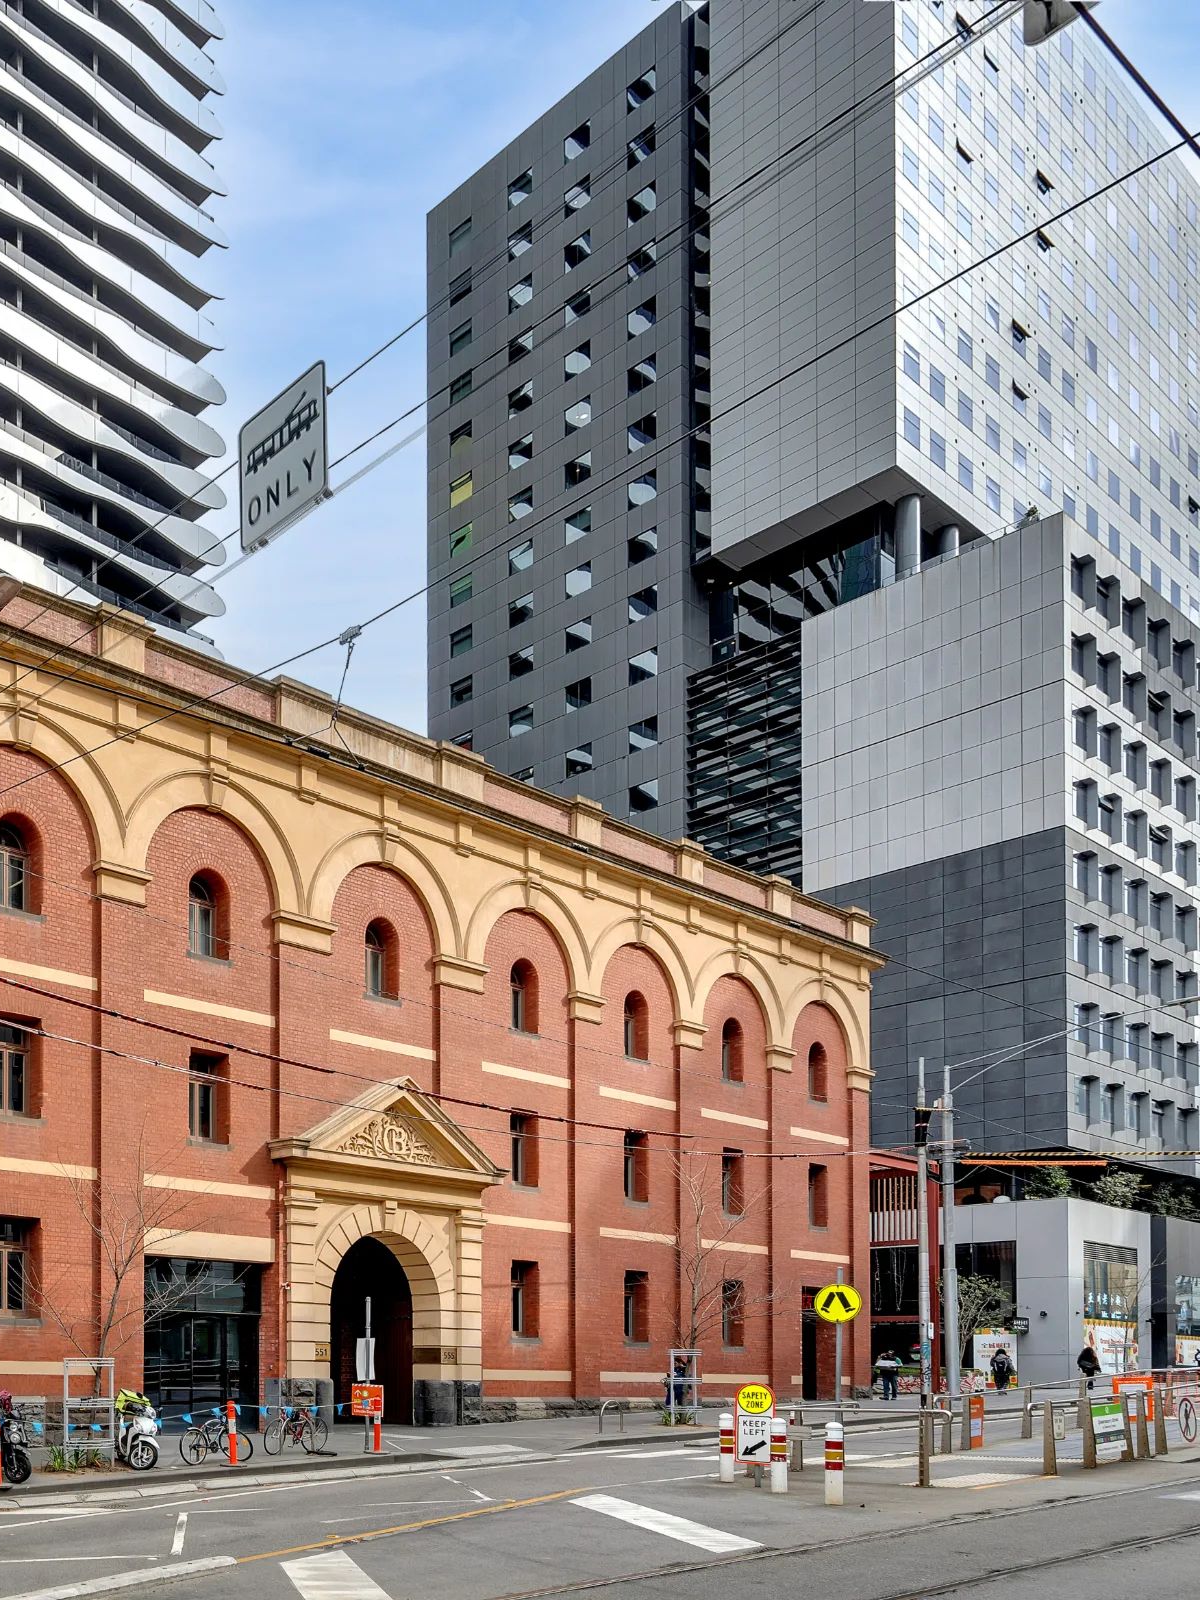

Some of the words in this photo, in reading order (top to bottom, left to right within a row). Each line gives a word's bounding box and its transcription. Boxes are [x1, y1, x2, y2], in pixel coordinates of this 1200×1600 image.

[248, 448, 317, 526] ONLY
[315, 1348, 328, 1356] 551
[443, 1351, 455, 1360] 555
[742, 1391, 768, 1400] SAFETY
[742, 1420, 767, 1428] KEEP
